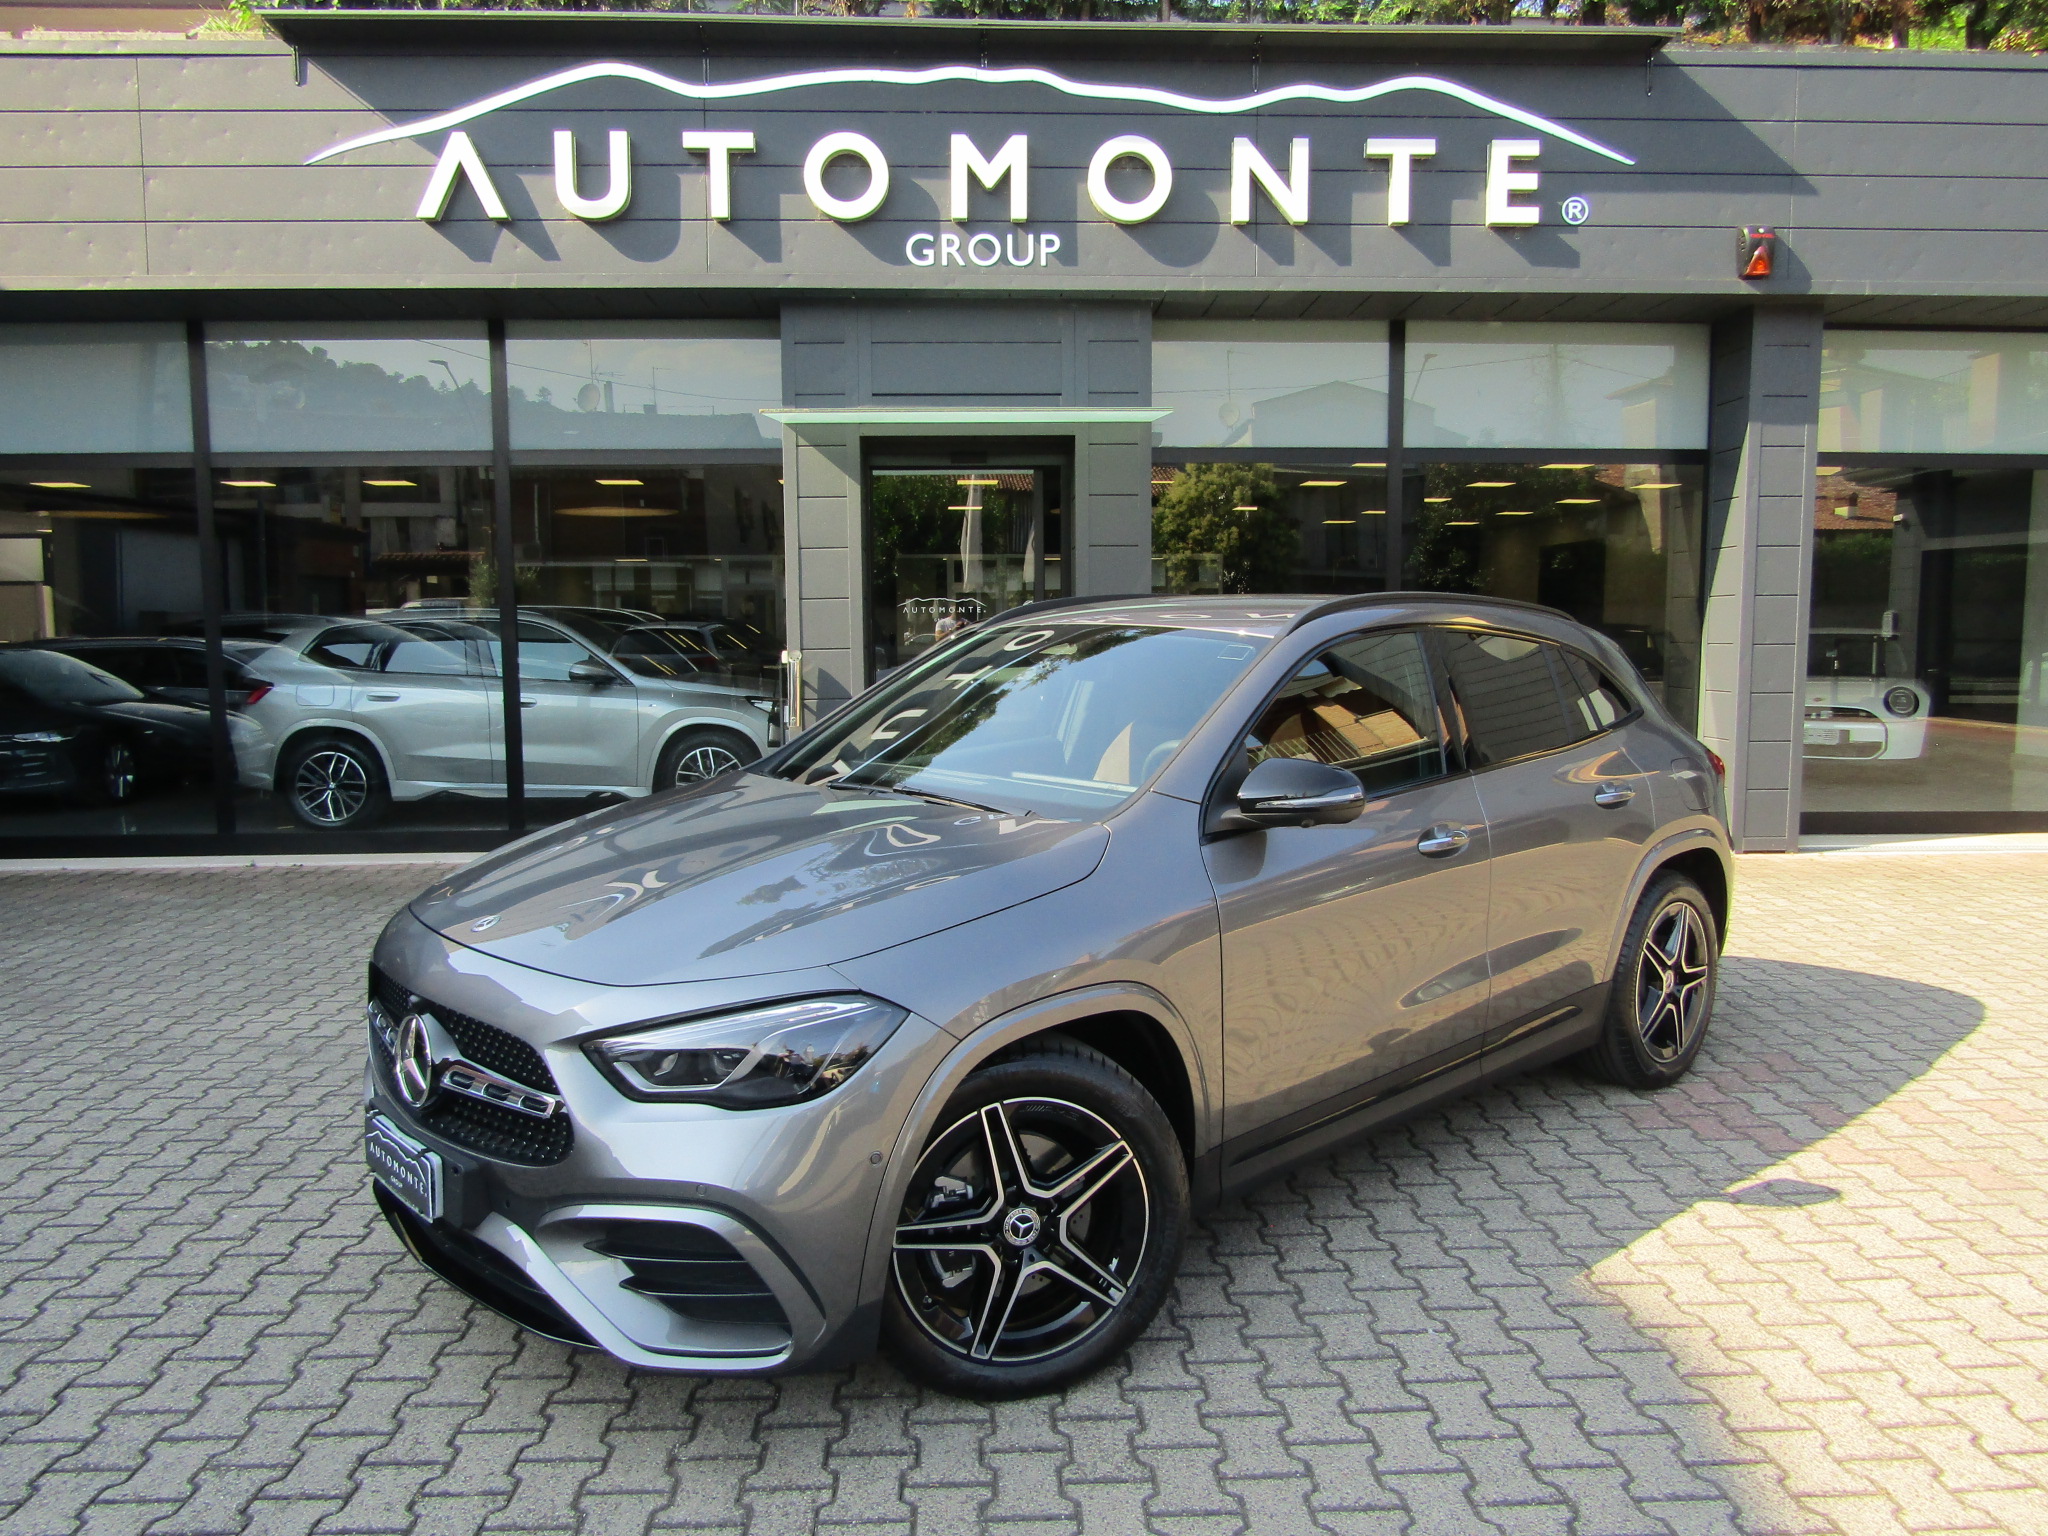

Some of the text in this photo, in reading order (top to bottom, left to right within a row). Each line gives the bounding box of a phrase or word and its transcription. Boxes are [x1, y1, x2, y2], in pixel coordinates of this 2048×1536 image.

[416, 130, 1540, 227] AUTOMONTE
[905, 232, 1061, 268] GROUP
[902, 606, 982, 614] AUTOMONTE
[369, 1141, 425, 1195] AUTOMONTE
